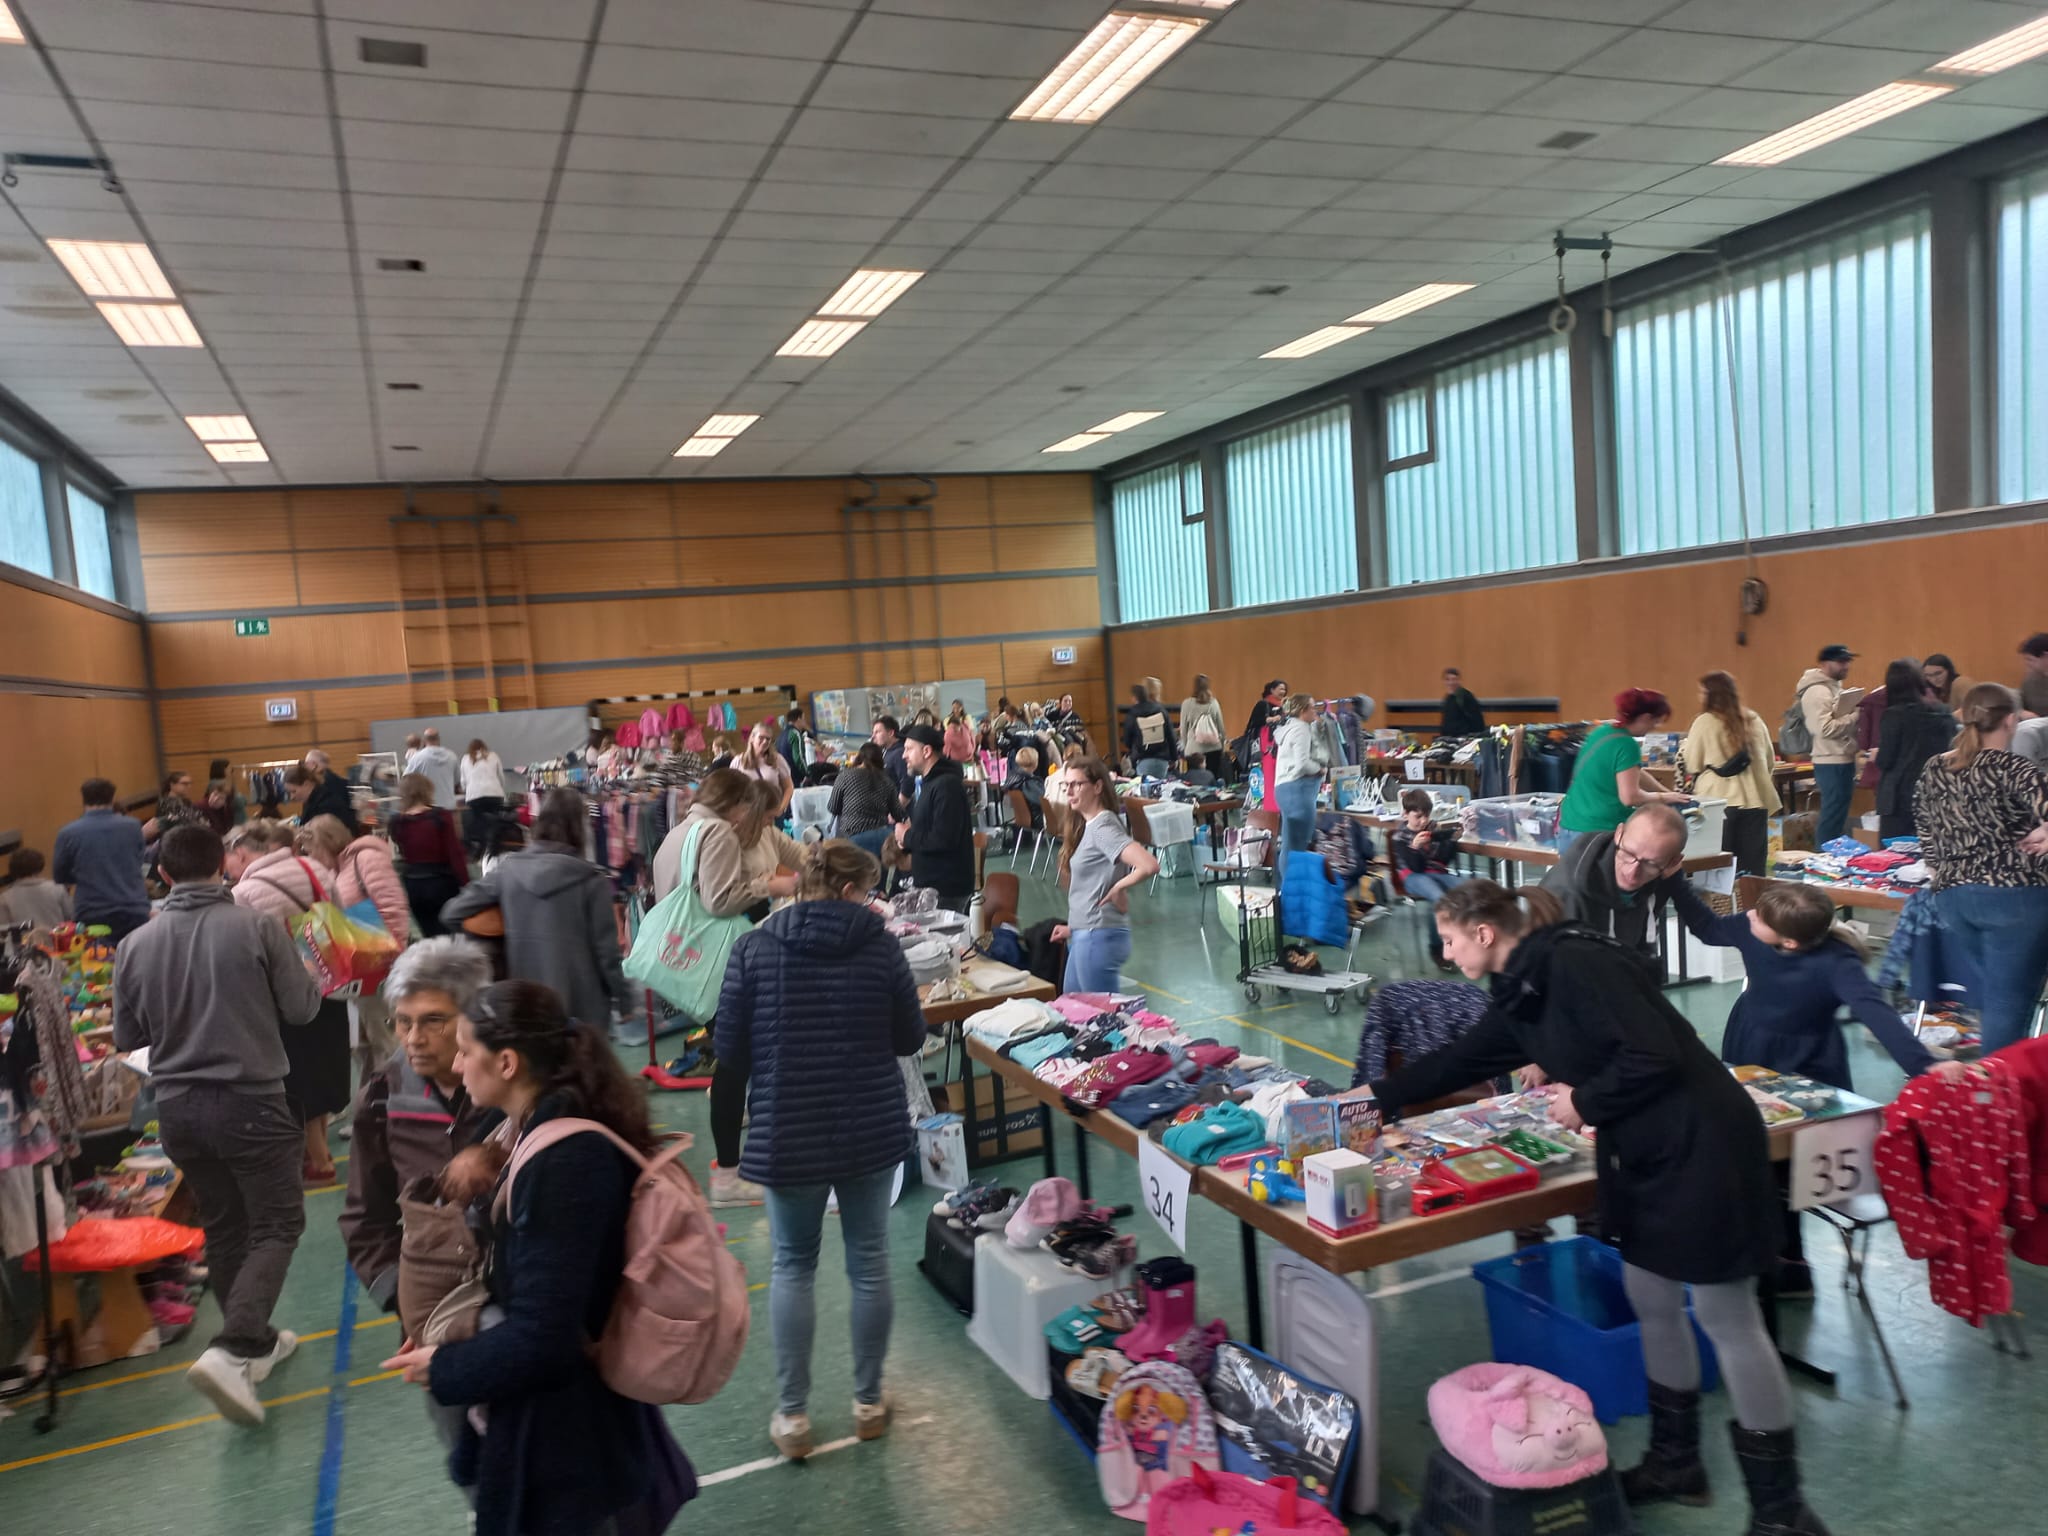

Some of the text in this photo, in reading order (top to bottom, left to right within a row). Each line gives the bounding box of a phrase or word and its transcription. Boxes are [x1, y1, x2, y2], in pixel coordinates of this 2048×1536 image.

[1340, 1101, 1369, 1118] AUTO
[1351, 1109, 1379, 1124] BINGO
[1810, 1148, 1861, 1197] 35
[1150, 1175, 1174, 1232] 34
